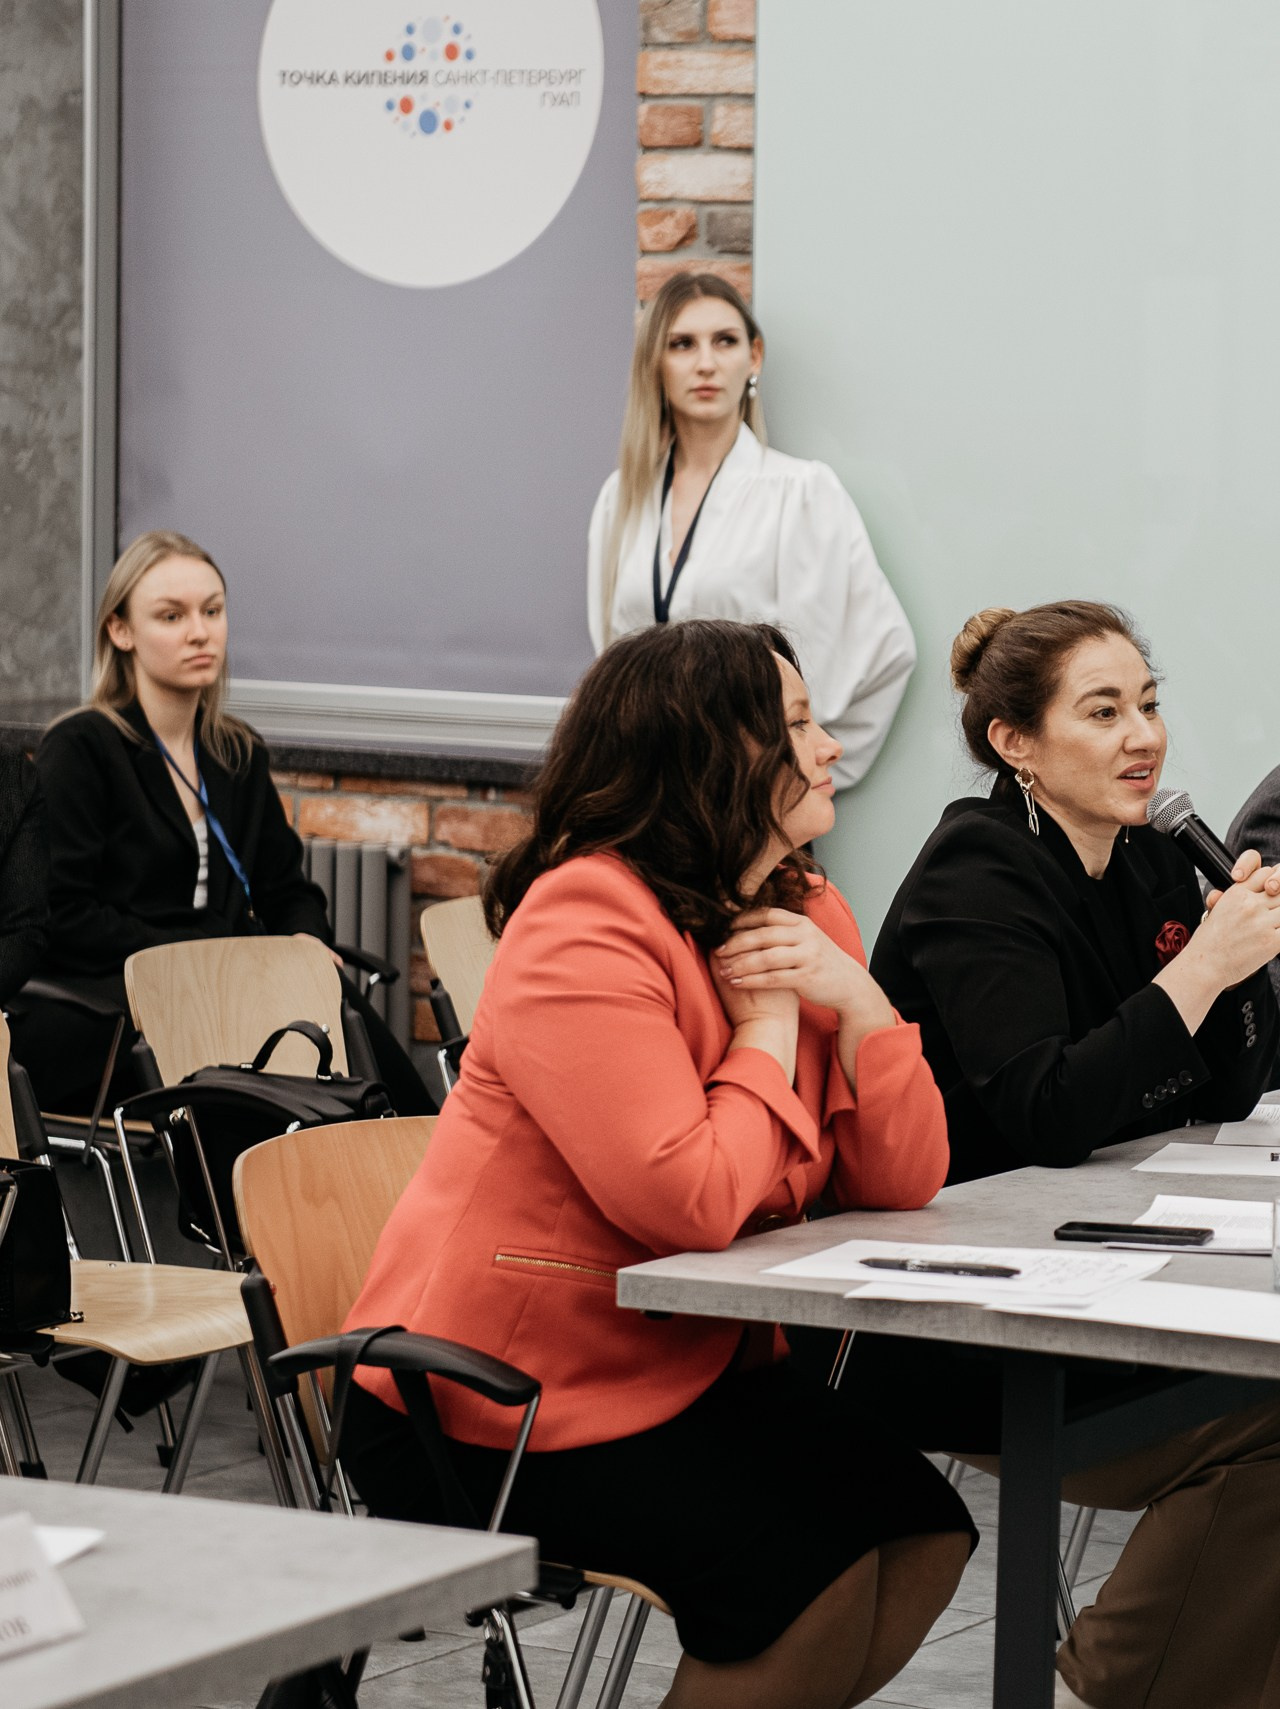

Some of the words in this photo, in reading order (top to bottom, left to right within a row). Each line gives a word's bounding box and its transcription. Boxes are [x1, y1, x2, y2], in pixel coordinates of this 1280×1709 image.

[278, 69, 340, 86] ТОЧКА
[344, 69, 429, 86] КИПЕНИЯ
[433, 69, 587, 86] САНКТ-ПЕТЕРБУРГ
[540, 91, 581, 107] ГУАП
